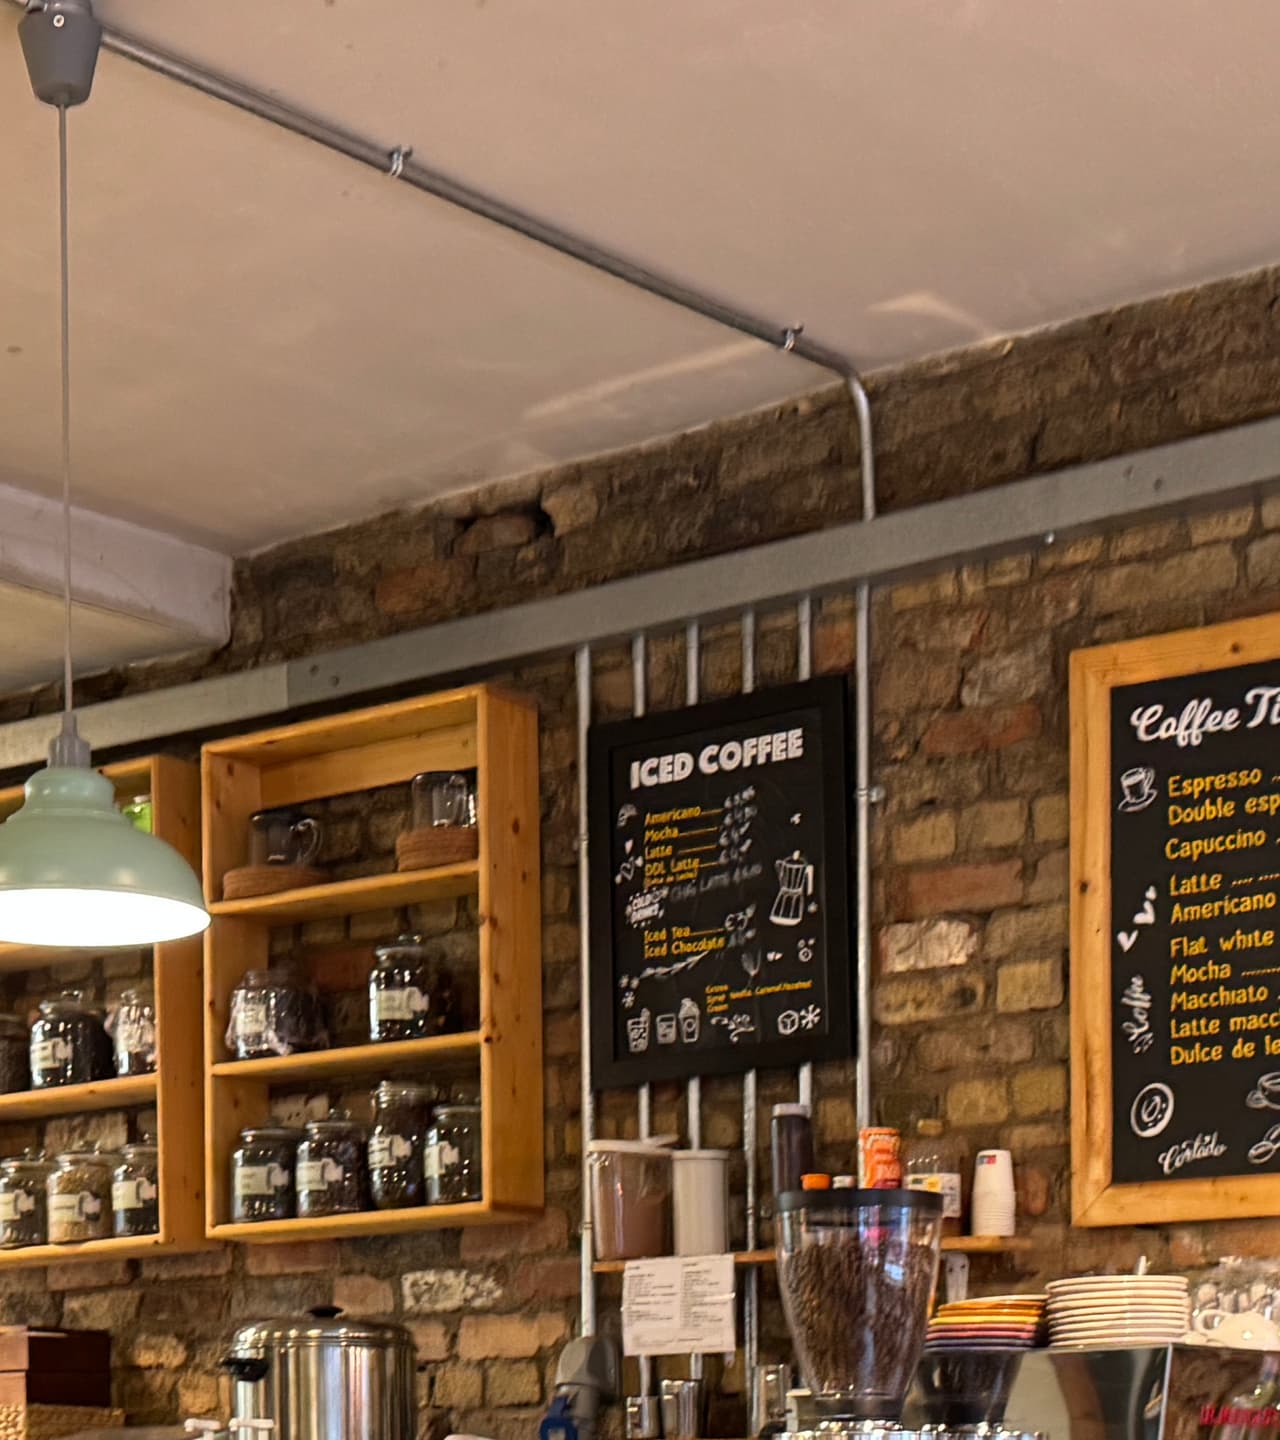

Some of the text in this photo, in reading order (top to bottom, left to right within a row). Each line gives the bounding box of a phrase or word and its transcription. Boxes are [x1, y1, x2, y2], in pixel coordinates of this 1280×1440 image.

[1130, 698, 1241, 748] Coffee
[630, 727, 805, 790] ICED COFFEE
[1168, 767, 1263, 799] Espresso
[1168, 796, 1235, 827] Double
[643, 826, 680, 844] Mocha
[1165, 827, 1267, 862] Capuccino
[644, 845, 673, 860] Latte
[670, 857, 700, 873] Latte
[1170, 870, 1223, 898] Latte
[1170, 892, 1277, 926] Americano
[644, 926, 692, 945] Iced Tea
[644, 942, 669, 959] Iced
[671, 936, 727, 956] Chocolate
[1170, 935, 1209, 959] Flat
[1219, 927, 1275, 951] white
[1170, 960, 1233, 986] Mocha
[1170, 984, 1269, 1012] Macchiato
[1170, 1015, 1221, 1040] Latte
[1170, 1041, 1223, 1066] Dulce
[1231, 1035, 1256, 1059] de
[1156, 1131, 1228, 1175] Cortado
